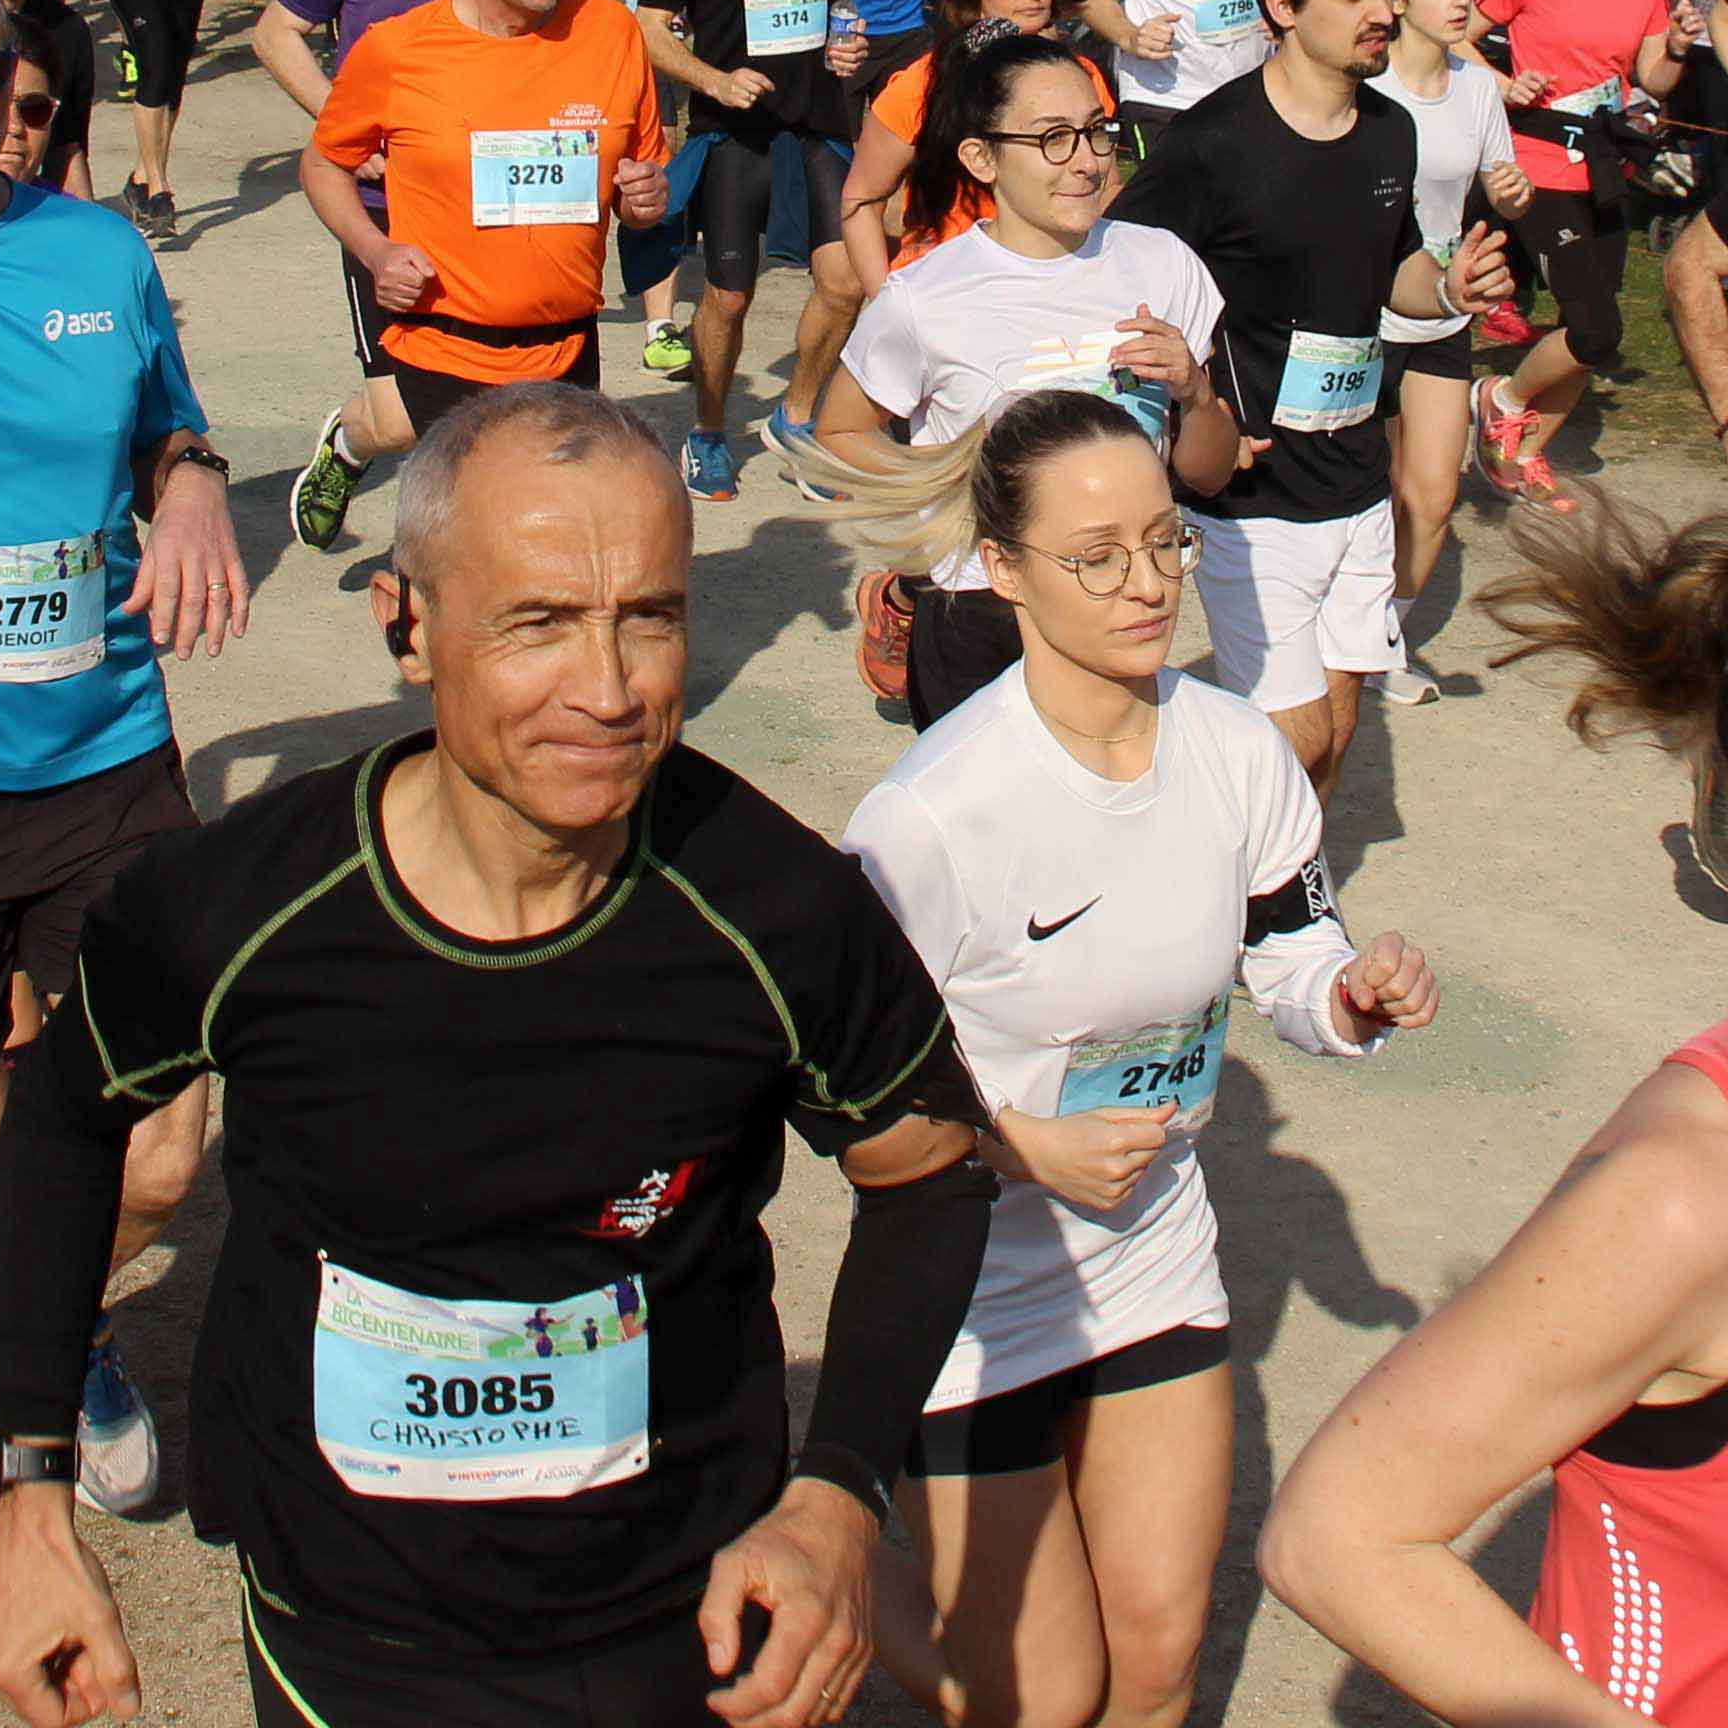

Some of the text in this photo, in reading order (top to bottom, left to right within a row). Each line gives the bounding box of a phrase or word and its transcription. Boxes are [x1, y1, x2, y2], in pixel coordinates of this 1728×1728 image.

[772, 10, 810, 29] 3174
[507, 163, 564, 186] 3278
[67, 310, 115, 336] asics
[1321, 371, 1366, 393] 3195
[1119, 1043, 1207, 1099] 2748
[331, 1302, 472, 1352] BICENTENAIRE
[404, 1372, 555, 1418] 3085
[370, 1418, 583, 1449] CHRISTOPHE
